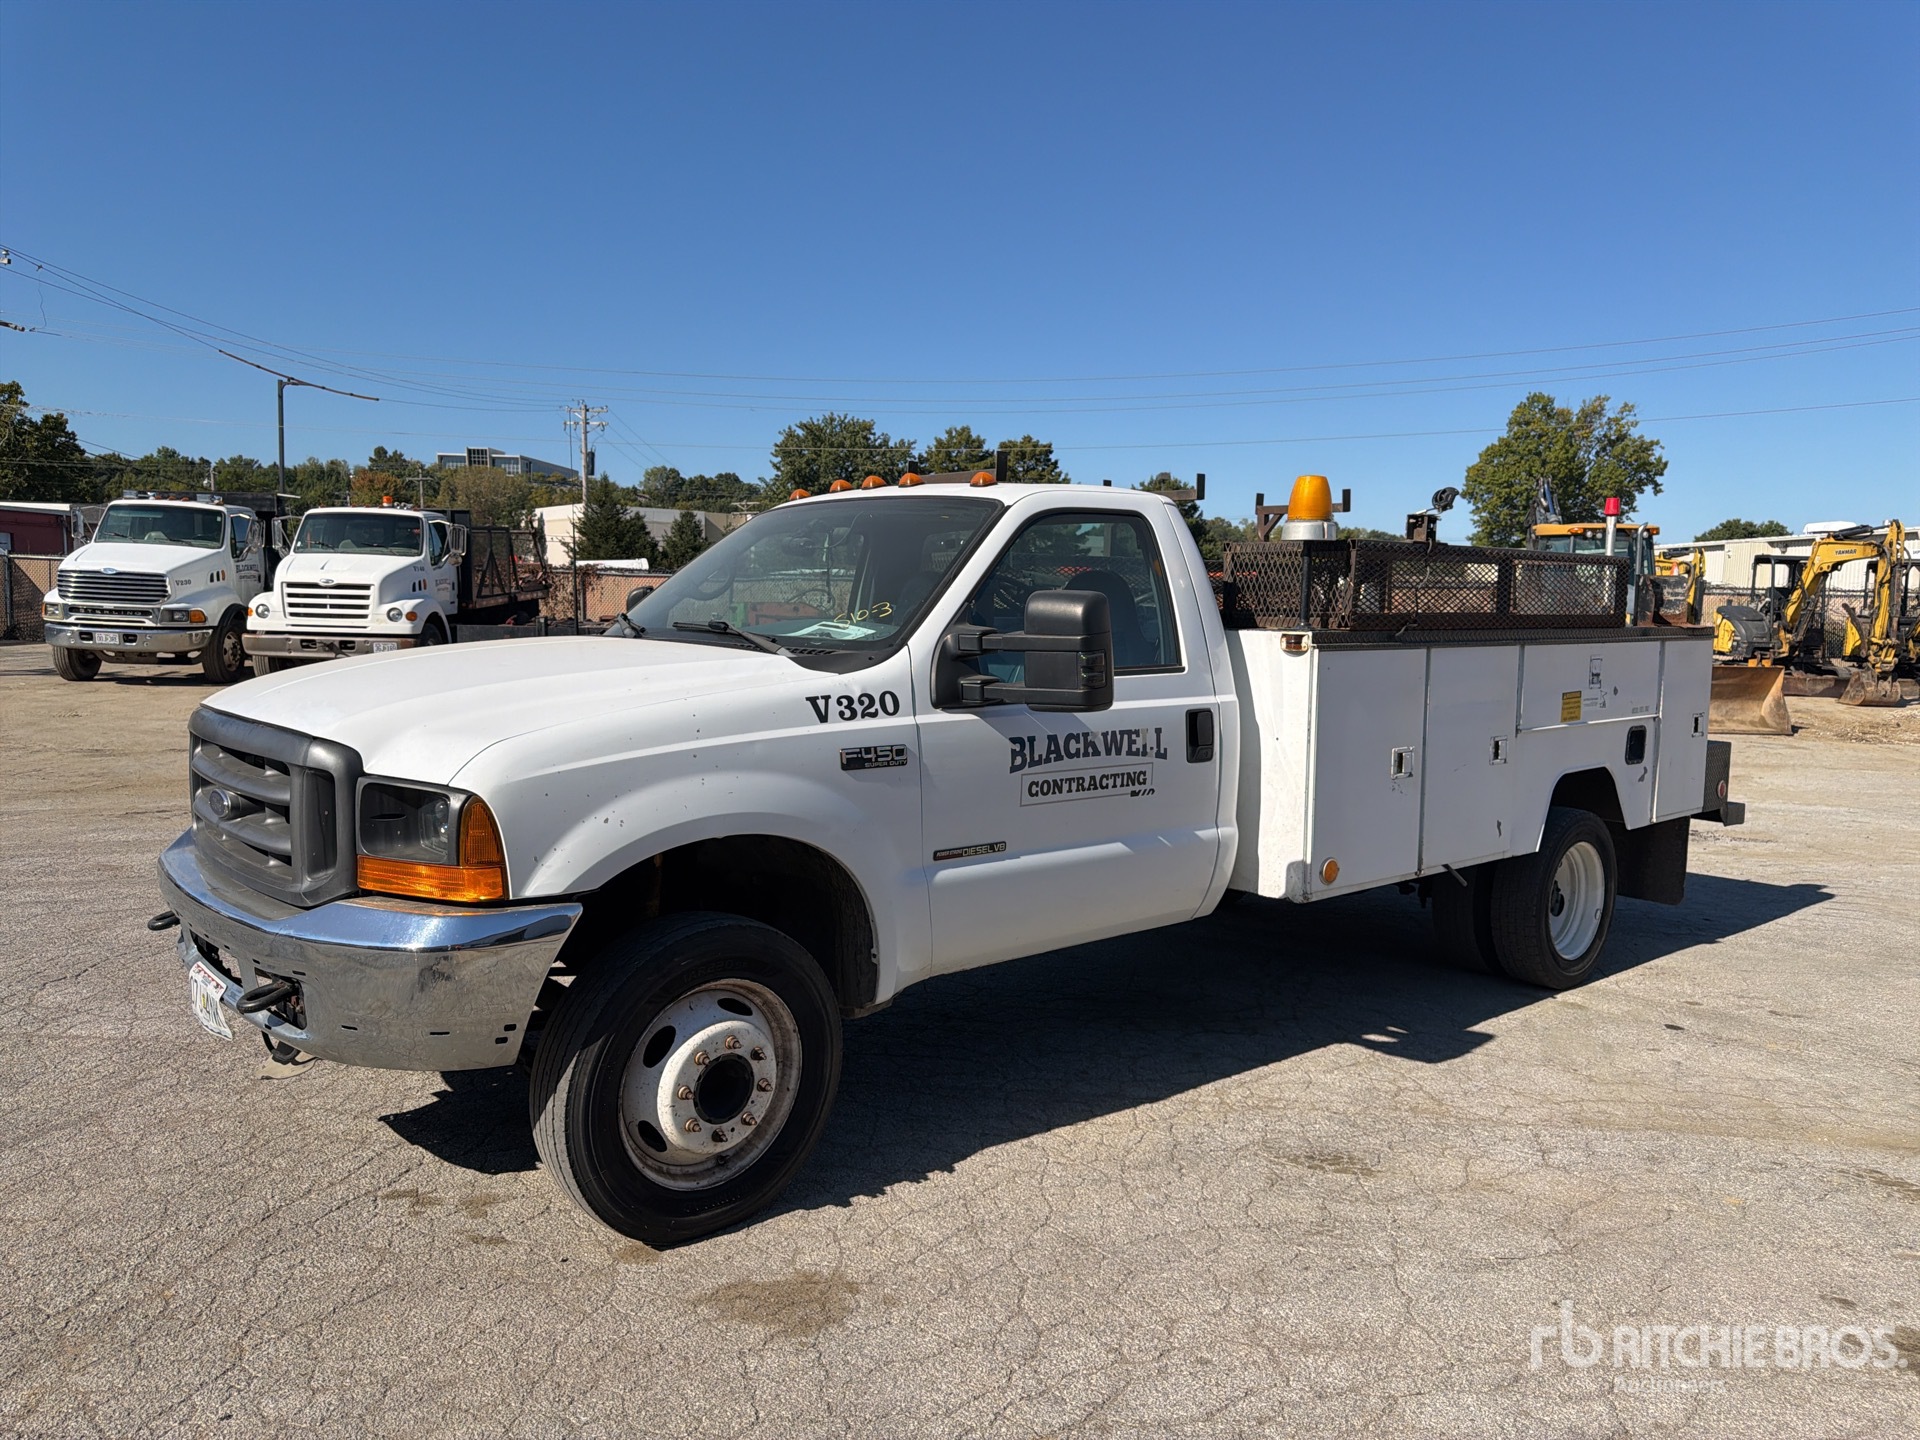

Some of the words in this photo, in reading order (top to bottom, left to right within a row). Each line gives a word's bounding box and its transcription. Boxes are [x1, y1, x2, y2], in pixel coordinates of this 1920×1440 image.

[79, 608, 142, 616] STERLING
[805, 690, 900, 723] V320
[1028, 770, 1147, 797] CONTRACTING
[962, 844, 993, 856] DIESEL
[993, 842, 1006, 852] V8
